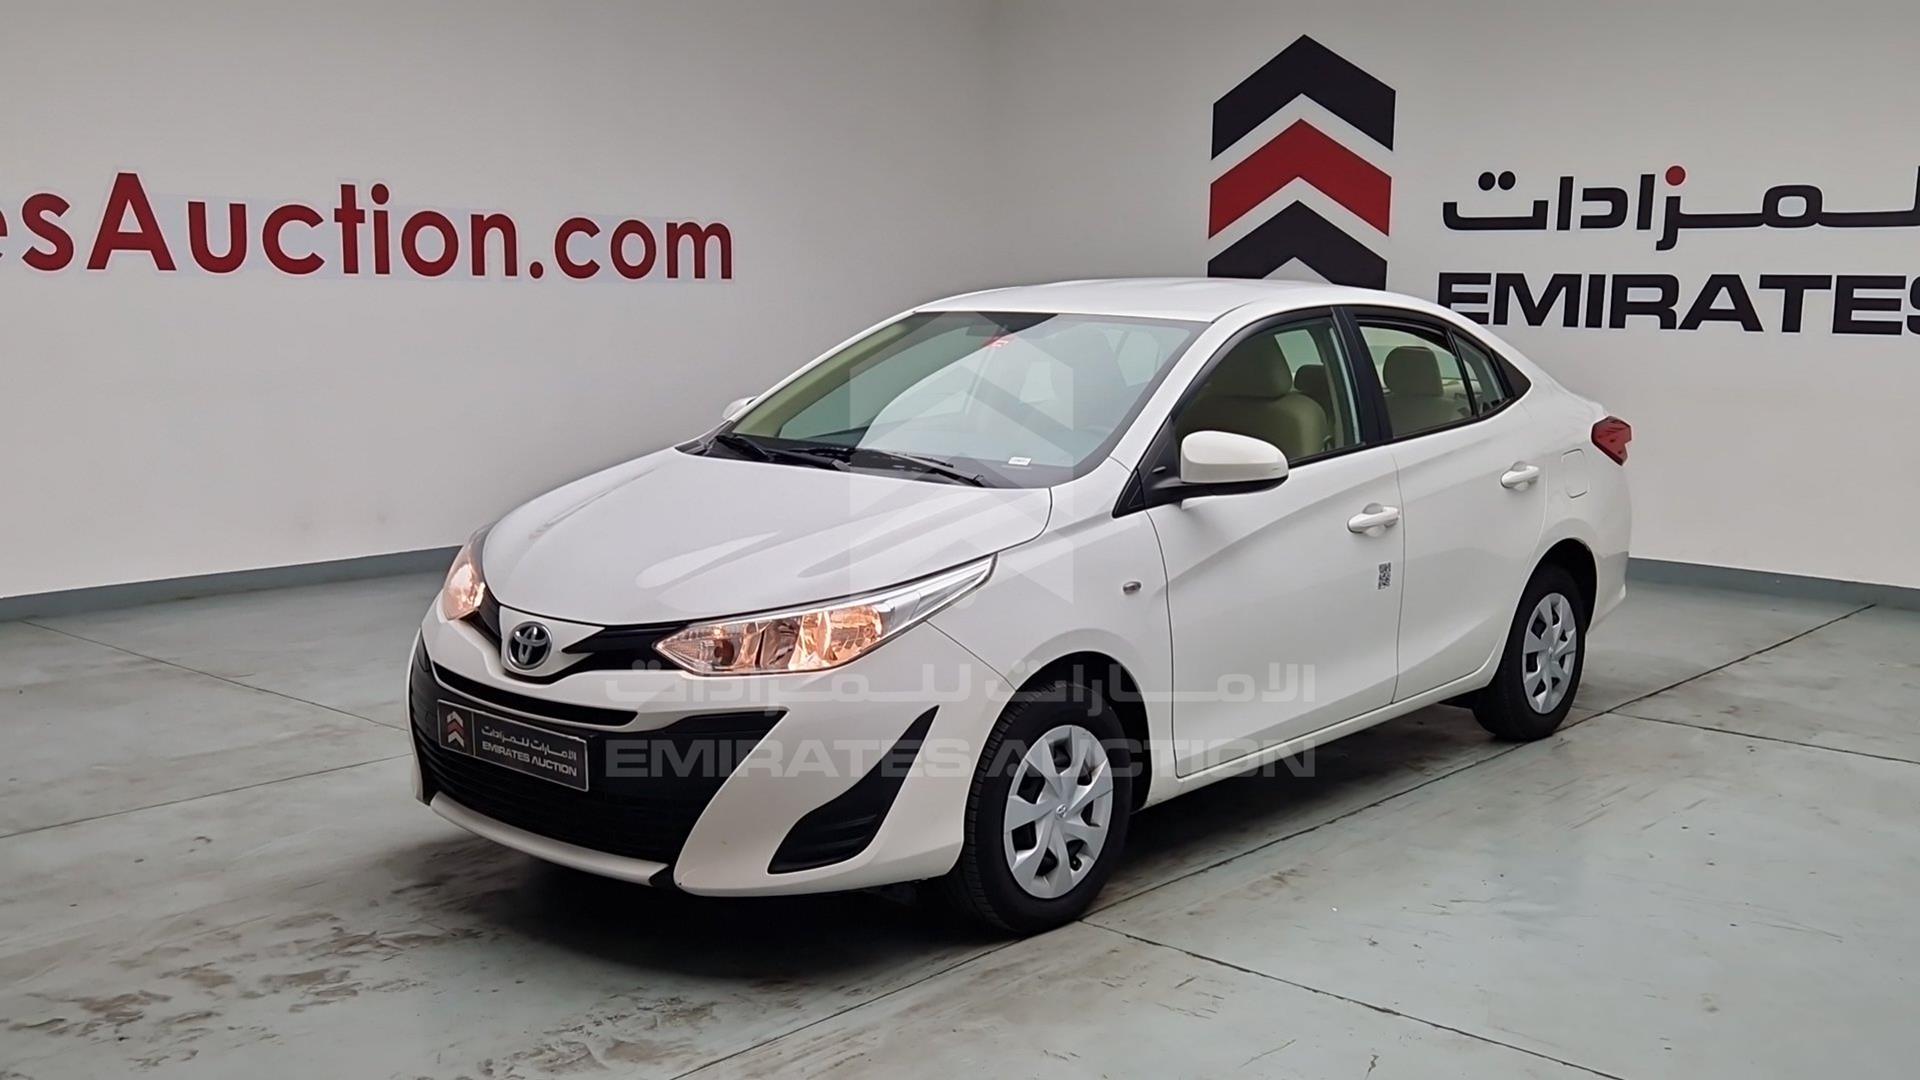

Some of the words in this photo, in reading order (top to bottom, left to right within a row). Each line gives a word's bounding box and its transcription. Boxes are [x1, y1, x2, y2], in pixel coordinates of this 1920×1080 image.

[0, 172, 732, 280] sAuction.com
[1438, 272, 1920, 335] EMIRATE
[482, 740, 530, 762] EMIRATES
[531, 755, 577, 777] AUCTION
